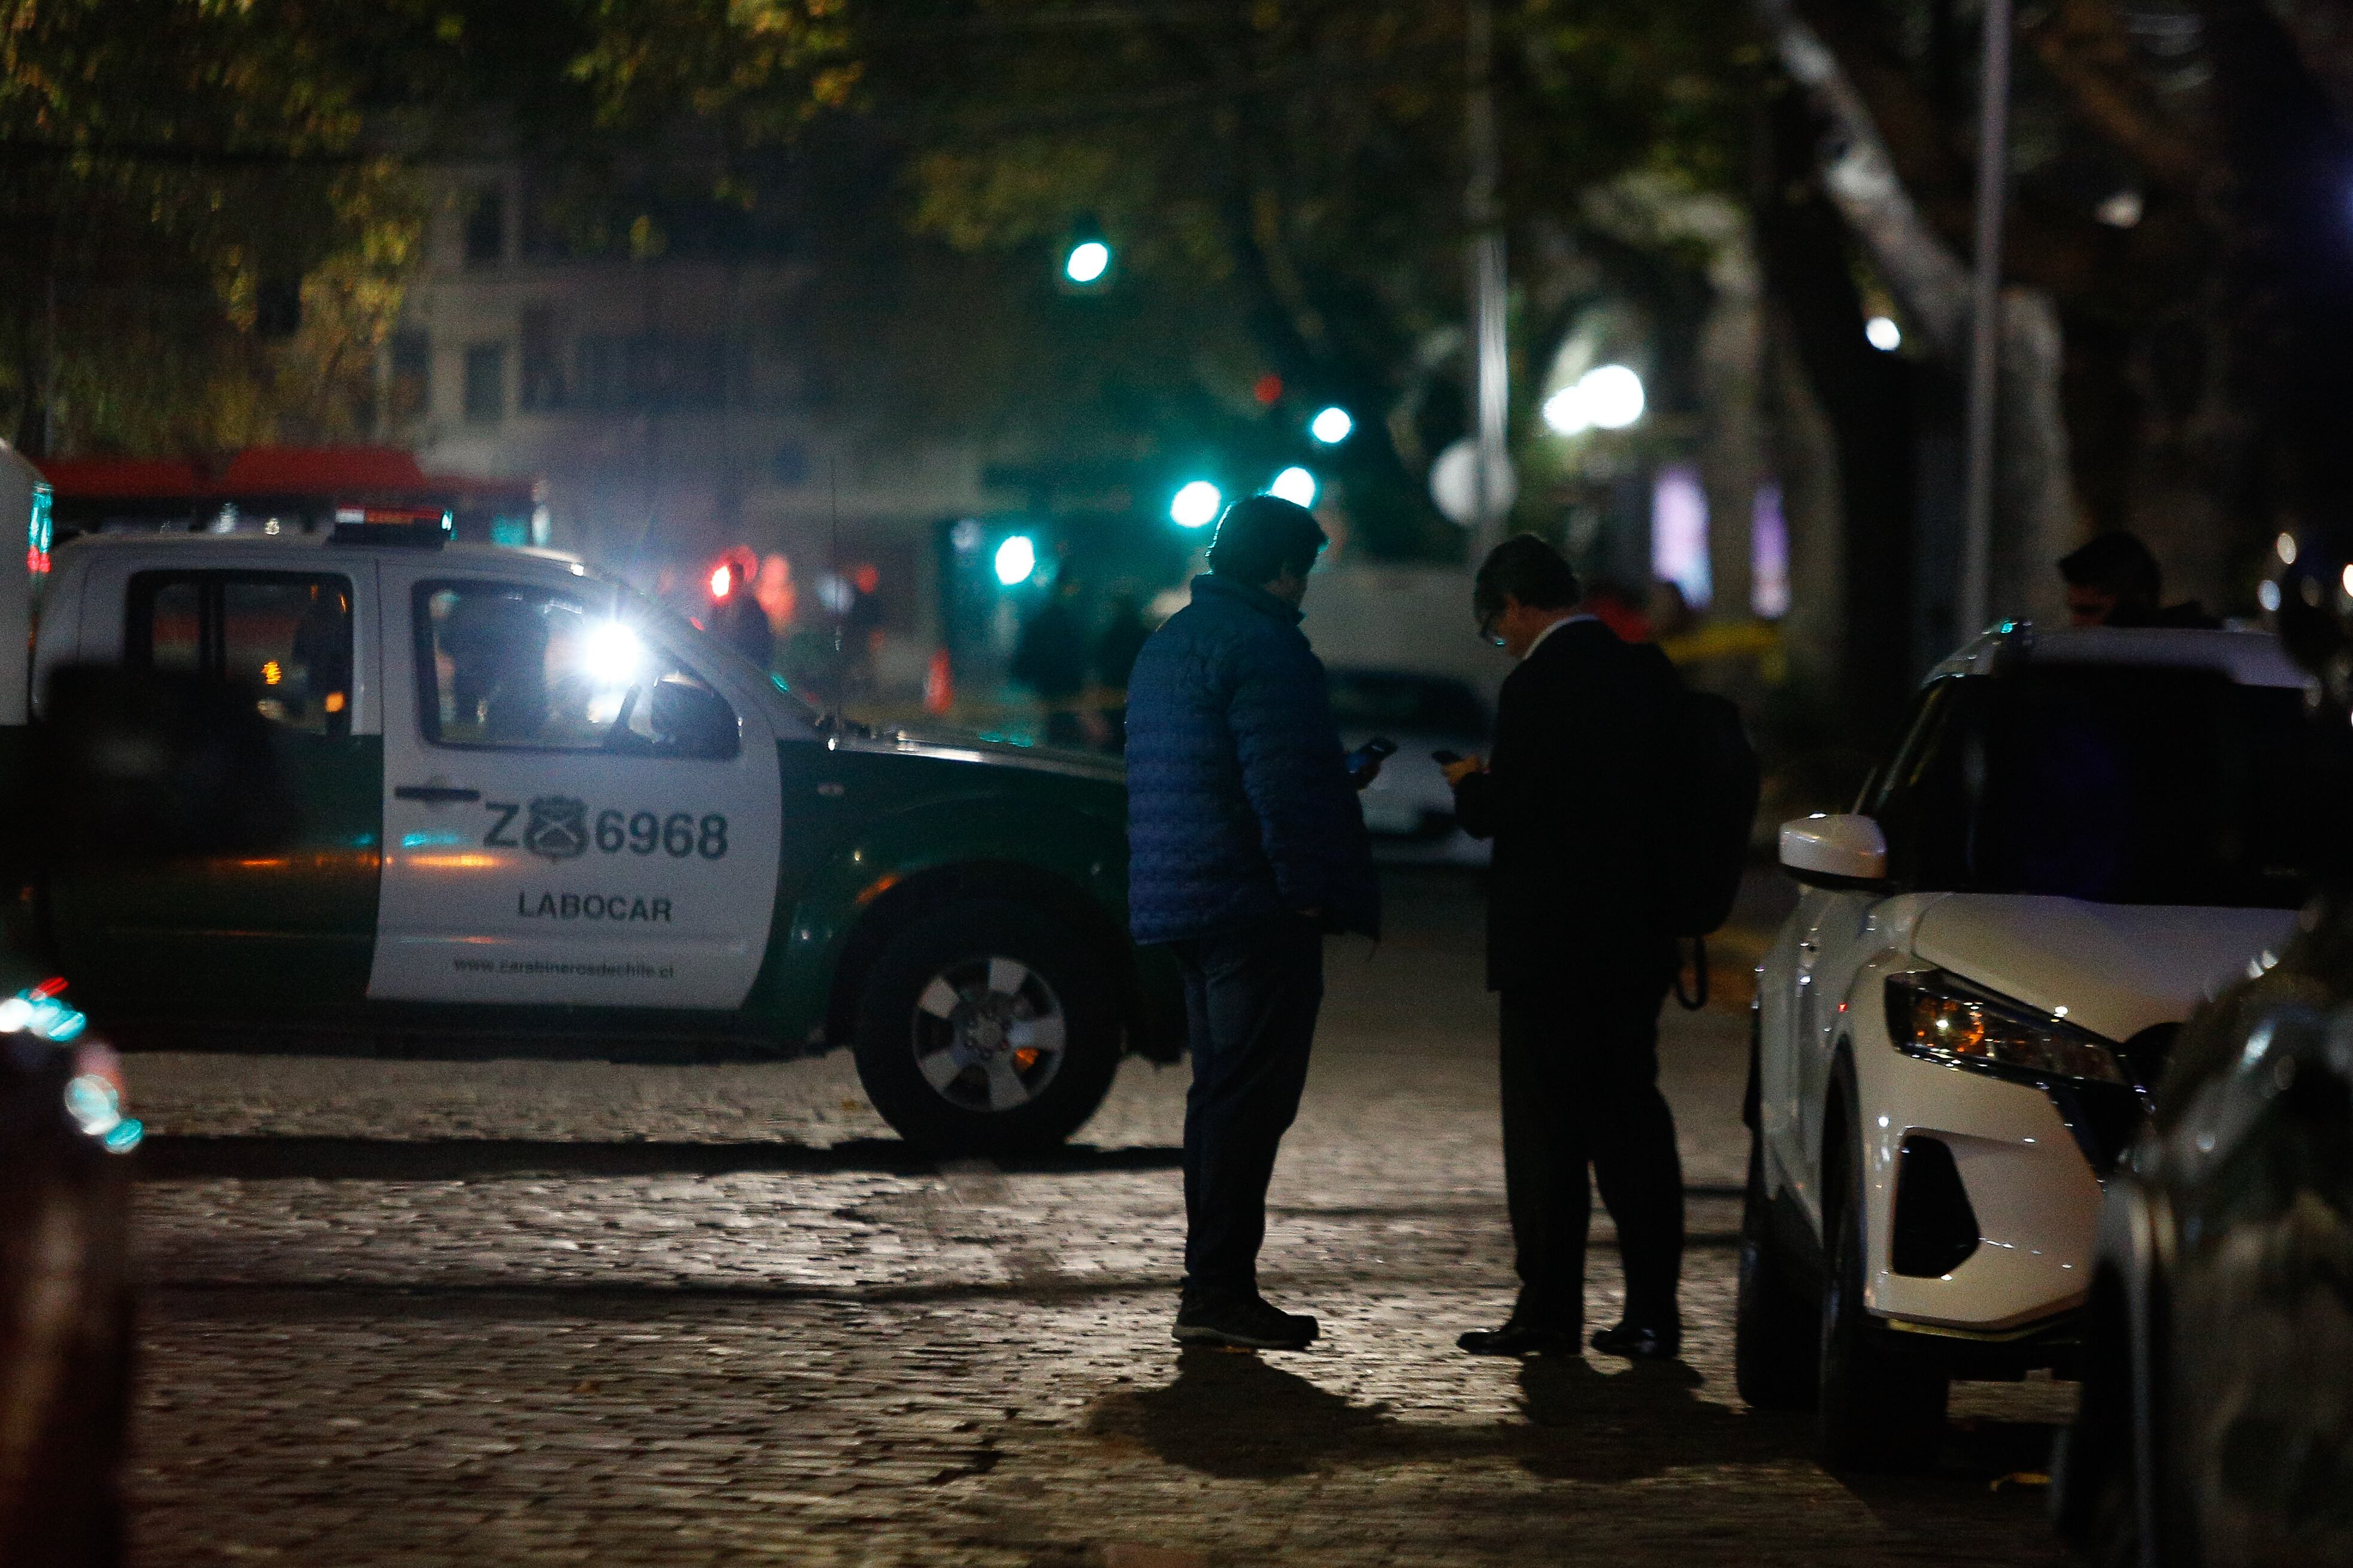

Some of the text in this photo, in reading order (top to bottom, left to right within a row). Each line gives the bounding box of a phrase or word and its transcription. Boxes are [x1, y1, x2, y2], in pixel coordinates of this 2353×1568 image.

[483, 801, 729, 860] Z 6968
[517, 891, 673, 923] LABOCAR
